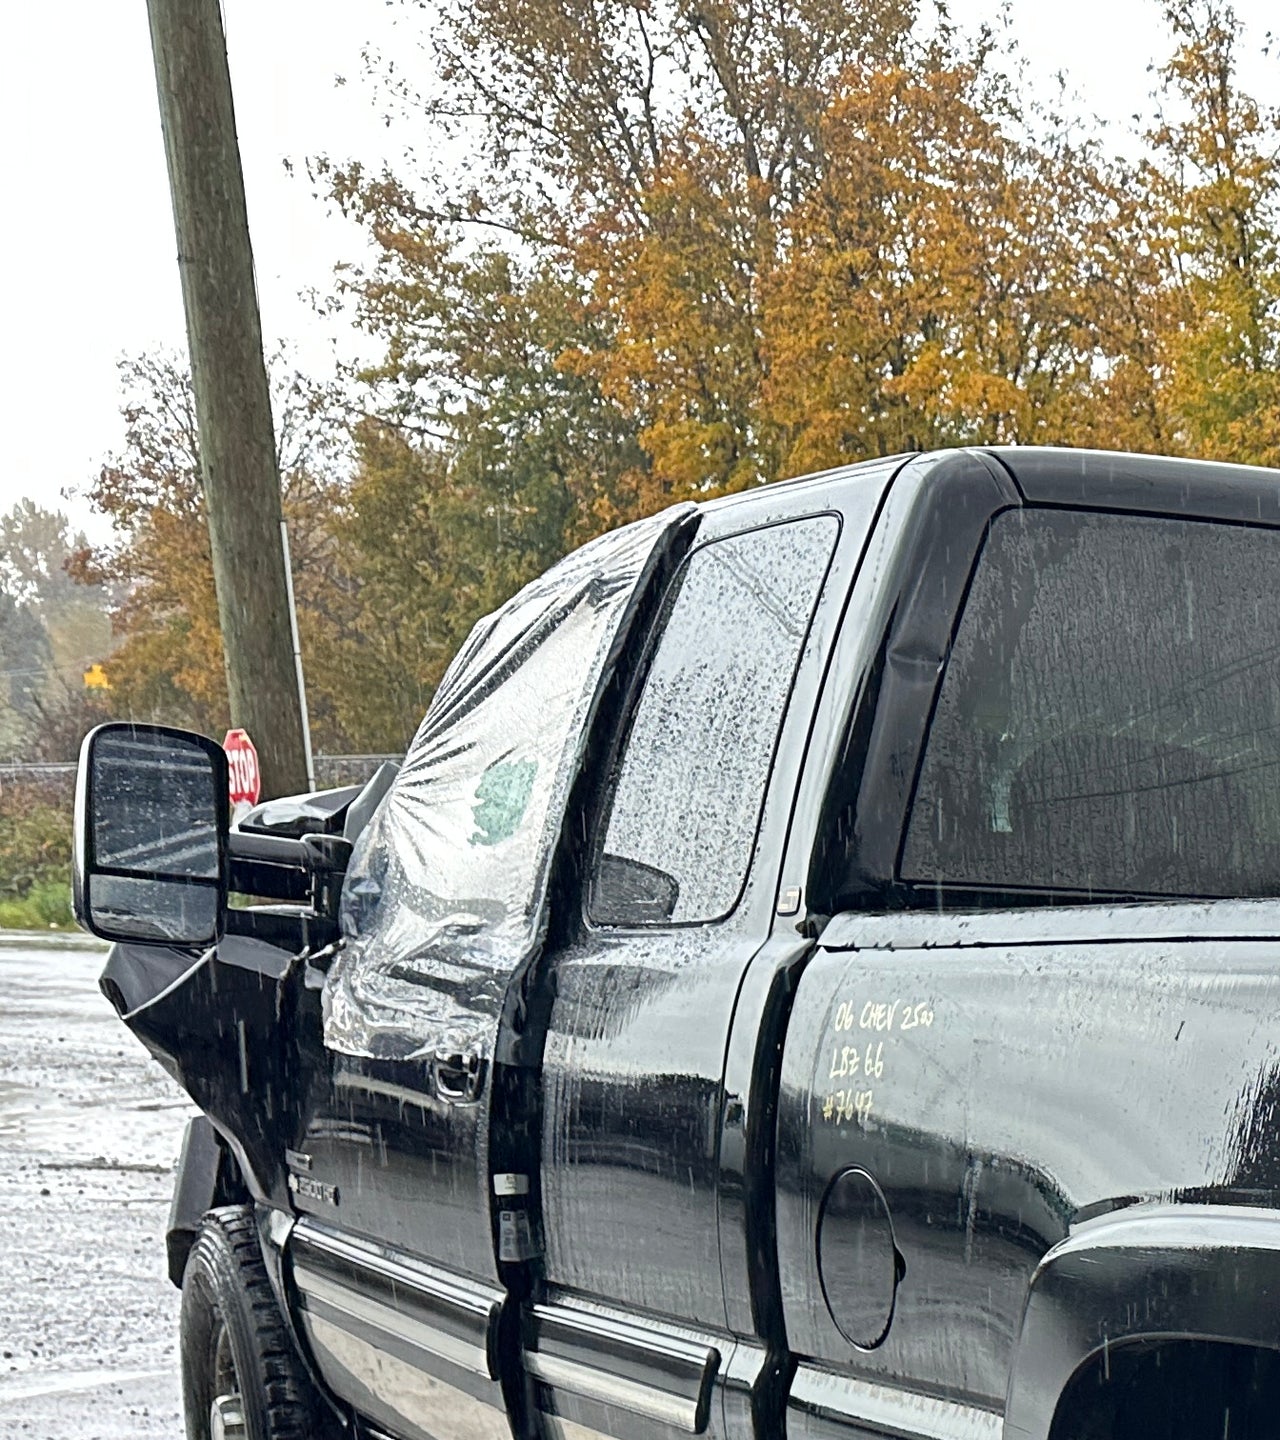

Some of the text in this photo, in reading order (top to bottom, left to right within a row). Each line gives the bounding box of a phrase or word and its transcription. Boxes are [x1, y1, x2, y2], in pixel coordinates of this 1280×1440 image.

[225, 748, 256, 794] STOP
[834, 1000, 855, 1032] 06
[859, 998, 901, 1032] CHEV
